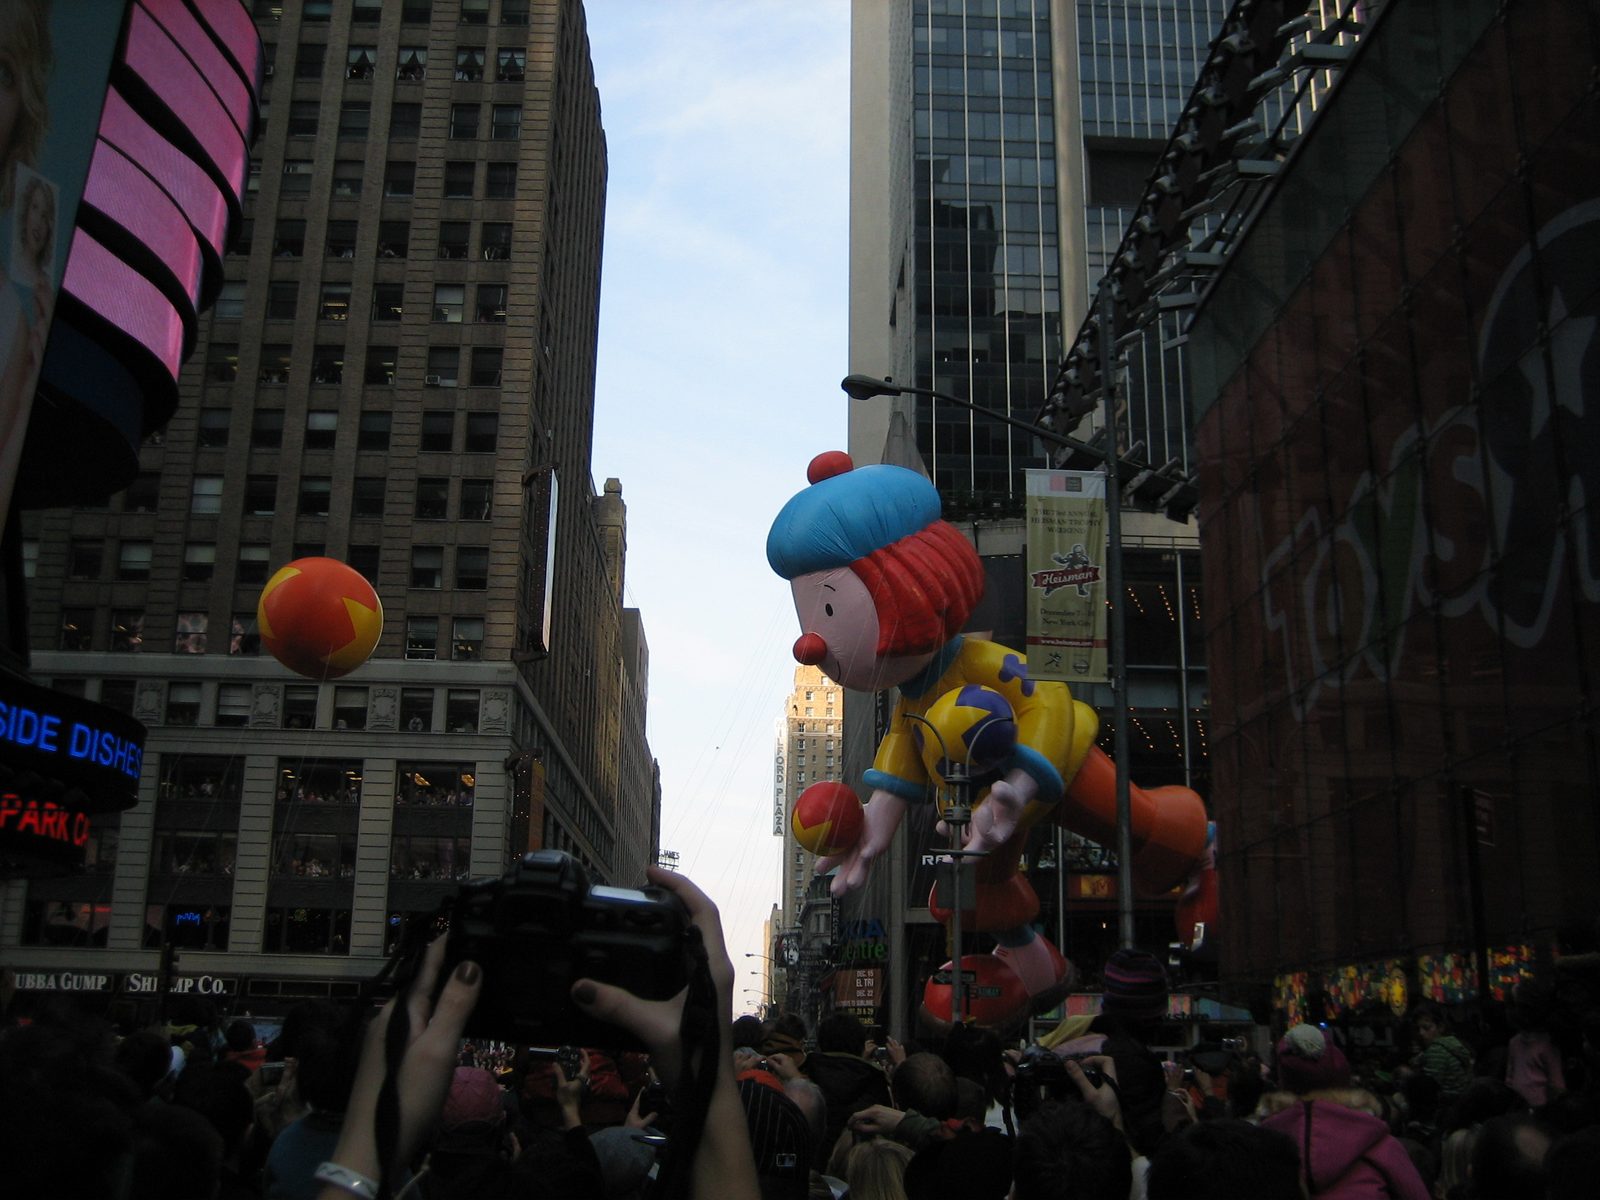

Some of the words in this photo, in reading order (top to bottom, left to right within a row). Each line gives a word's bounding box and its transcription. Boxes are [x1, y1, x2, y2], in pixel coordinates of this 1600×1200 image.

[1042, 570, 1094, 585] Heisman
[0, 792, 71, 843] PARK
[774, 788, 784, 835] PLAZA
[15, 973, 57, 989] UBBA
[60, 972, 107, 990] GUMP
[128, 973, 193, 993] SHMP
